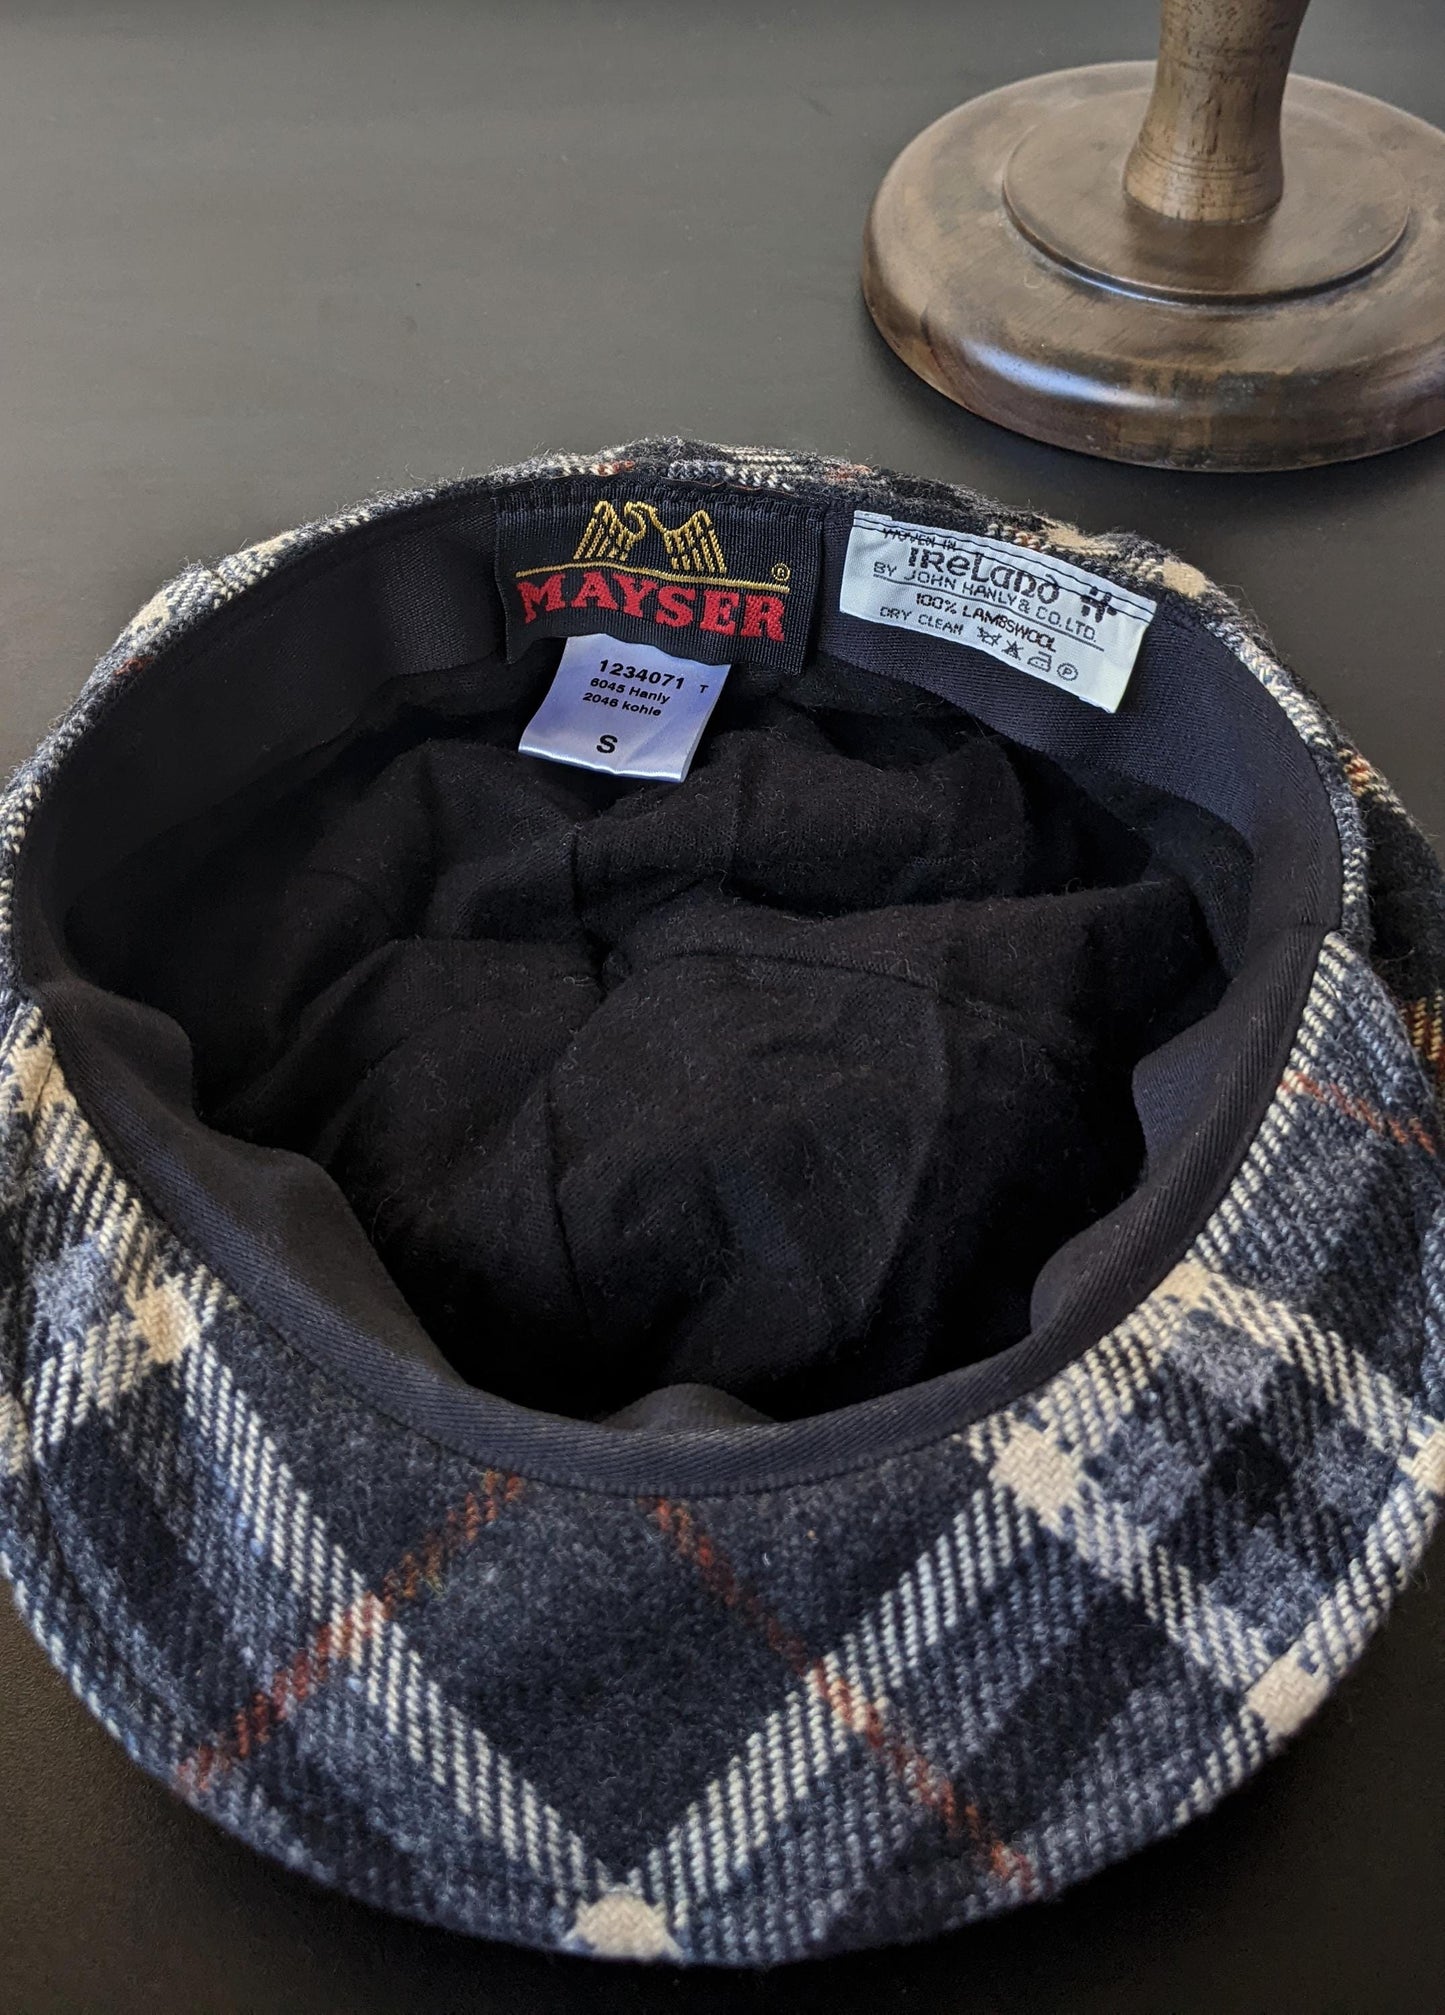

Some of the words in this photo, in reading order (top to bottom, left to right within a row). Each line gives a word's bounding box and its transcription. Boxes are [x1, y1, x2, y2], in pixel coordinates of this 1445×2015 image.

[873, 561, 897, 577] BY
[904, 569, 956, 591] JOHN
[962, 580, 1017, 608] HANLY
[1018, 600, 1031, 615] &
[516, 571, 786, 642] MAYSER
[879, 605, 912, 621] DRY
[918, 613, 964, 636] CLEAN
[915, 592, 957, 615] 100%
[962, 604, 1057, 653] LAMBSWOOL
[590, 677, 625, 694] 6045
[628, 686, 671, 705] Hanly
[599, 658, 686, 690] 1234071
[699, 684, 709, 694] T
[621, 700, 662, 717] kohle
[596, 734, 619, 754] S
